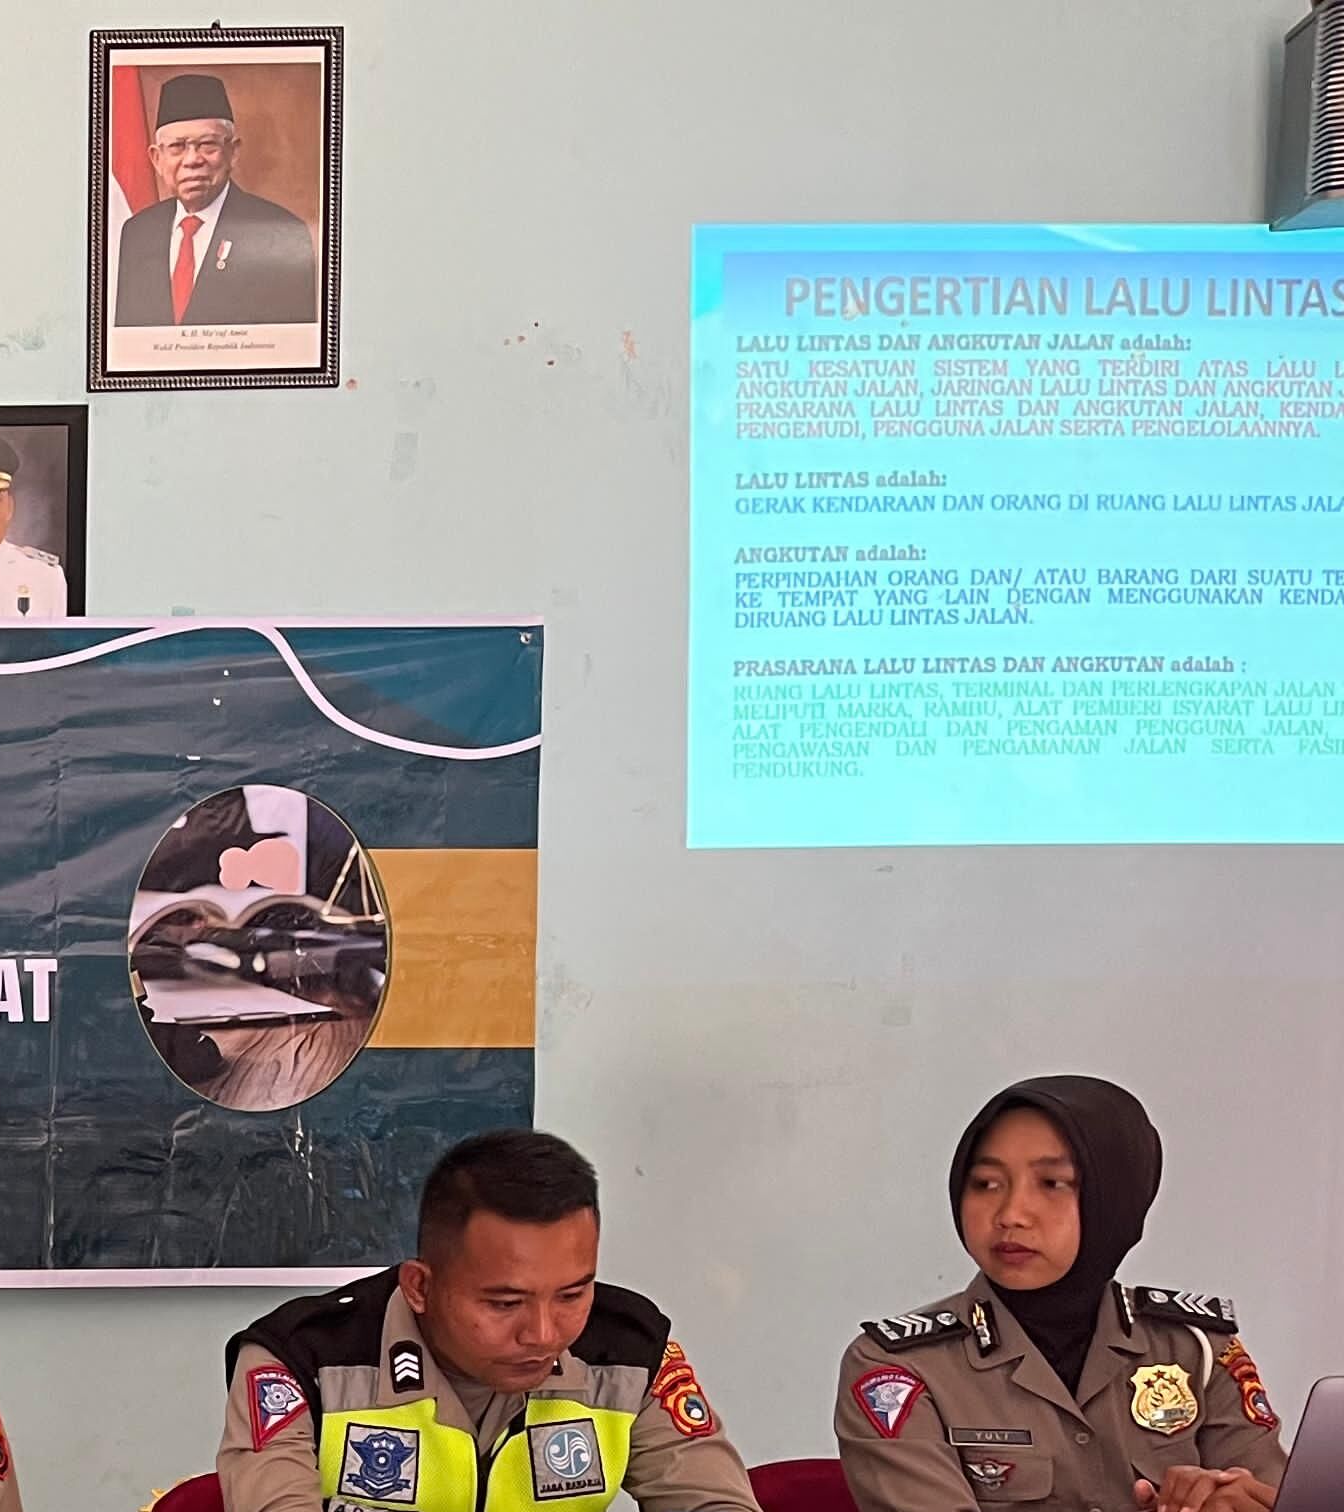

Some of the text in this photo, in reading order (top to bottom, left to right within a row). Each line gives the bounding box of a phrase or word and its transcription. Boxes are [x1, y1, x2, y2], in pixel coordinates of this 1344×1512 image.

[784, 276, 1068, 317] PENGERTIAN
[1085, 277, 1191, 317] LALU
[736, 333, 1192, 352] LALU LINTAS DAN ANGKUTAN JALAN adalah:
[736, 360, 789, 378] SATU
[808, 360, 916, 378] KESATUAN
[934, 359, 1009, 377] SISTEM
[1026, 359, 1080, 377] YANG
[1098, 359, 1180, 377] TERDIRI
[1198, 360, 1248, 377] ATAS
[1267, 360, 1317, 378] LALU
[736, 380, 848, 398] ANGKUTAN
[854, 379, 924, 399] JALAN,
[931, 379, 1032, 397] JARINGAN
[1040, 379, 1090, 396] LALU
[1098, 379, 1168, 397] LINTAS
[1175, 380, 1217, 397] DAN
[1223, 380, 1333, 398] ANGKUTAN
[736, 401, 856, 418] PRASARANA
[869, 400, 921, 418] LALU
[934, 400, 1004, 417] LINTAS
[1018, 400, 1058, 417] DAN
[1072, 400, 1184, 417] ANGKUTAN
[1196, 400, 1265, 420] JALAN,
[736, 420, 1321, 440] PENGEMUDI, PENGGUNA JALAN SERTA PENGELOLAANNYA.
[735, 469, 947, 490] LALU LINTAS adalah:
[735, 497, 806, 514] GERAK
[813, 495, 936, 513] KENDARAAN
[943, 494, 985, 512] DAN
[991, 494, 1061, 512] ORANG
[1068, 494, 1089, 511] DI
[1096, 494, 1167, 511] RUANG
[1173, 494, 1223, 511] LALU
[1229, 495, 1297, 512] LINTAS
[734, 544, 927, 564] ANGKUTAN adalah:
[735, 571, 877, 589] PERPINDAHAN
[888, 569, 959, 586] ORANG
[970, 568, 1023, 588] DAN/
[1034, 568, 1087, 585] ATAU
[1097, 568, 1179, 586] BARANG
[1190, 568, 1237, 586] DARI
[1247, 568, 1313, 586] SUATU
[735, 591, 763, 608] KE
[777, 590, 858, 607] TEMPAT
[874, 589, 928, 606] YANG
[944, 588, 990, 605] LAIN
[1006, 588, 1091, 605] DENGAN
[1107, 588, 1263, 605] MENGGUNAKAN
[735, 606, 1034, 628] DIRUANG LALU LINTAS JALAN.
[733, 659, 858, 677] PRASARANA
[863, 658, 917, 675] LALU
[922, 657, 997, 674] LINTAS
[1003, 657, 1045, 674] DAN
[1051, 656, 1165, 673] ANGKUTAN
[1170, 655, 1235, 673] adalah
[733, 680, 1336, 701] RUANG LALU LINTAS, TERMINAL DAN PERLENGKAPAN JALAN
[732, 720, 1329, 740] ALAT PENGENDALI DAN PENGAMAN PENGGUNA JALAN,
[733, 741, 870, 759] PENGAWASAN
[895, 740, 937, 757] DAN
[963, 739, 1100, 756] PENGAMANAN
[1123, 738, 1187, 755] JALAN
[1211, 738, 1274, 756] SERTA
[733, 761, 865, 779] PENDUKUNG.
